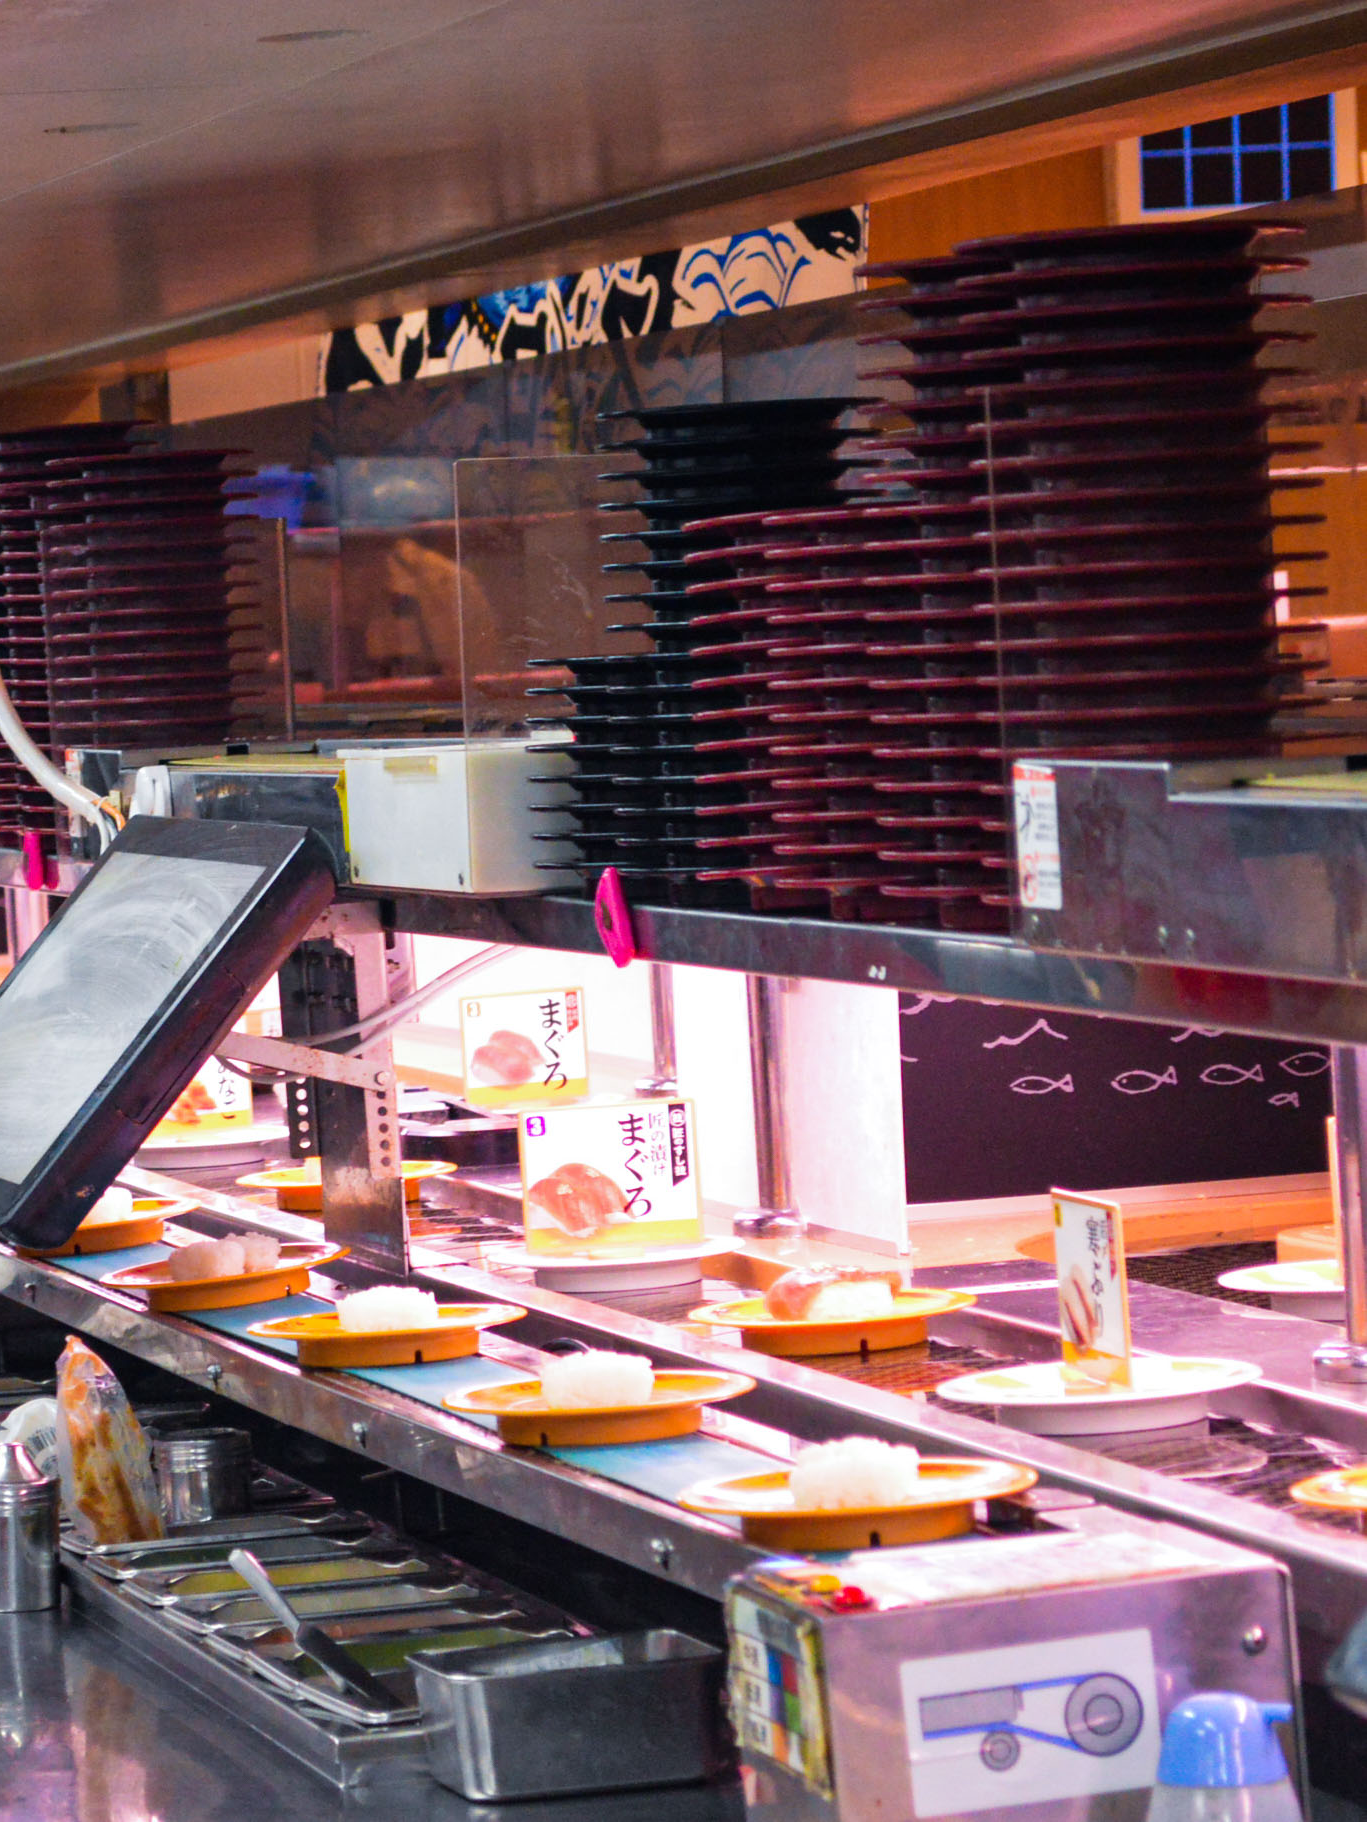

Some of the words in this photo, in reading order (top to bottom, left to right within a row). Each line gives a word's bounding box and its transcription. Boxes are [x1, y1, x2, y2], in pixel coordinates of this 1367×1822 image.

[539, 998, 568, 1090] まぐろ
[530, 1118, 543, 1136] 3
[618, 1113, 652, 1218] まぐろ
[648, 1111, 668, 1177] 匠の漬け
